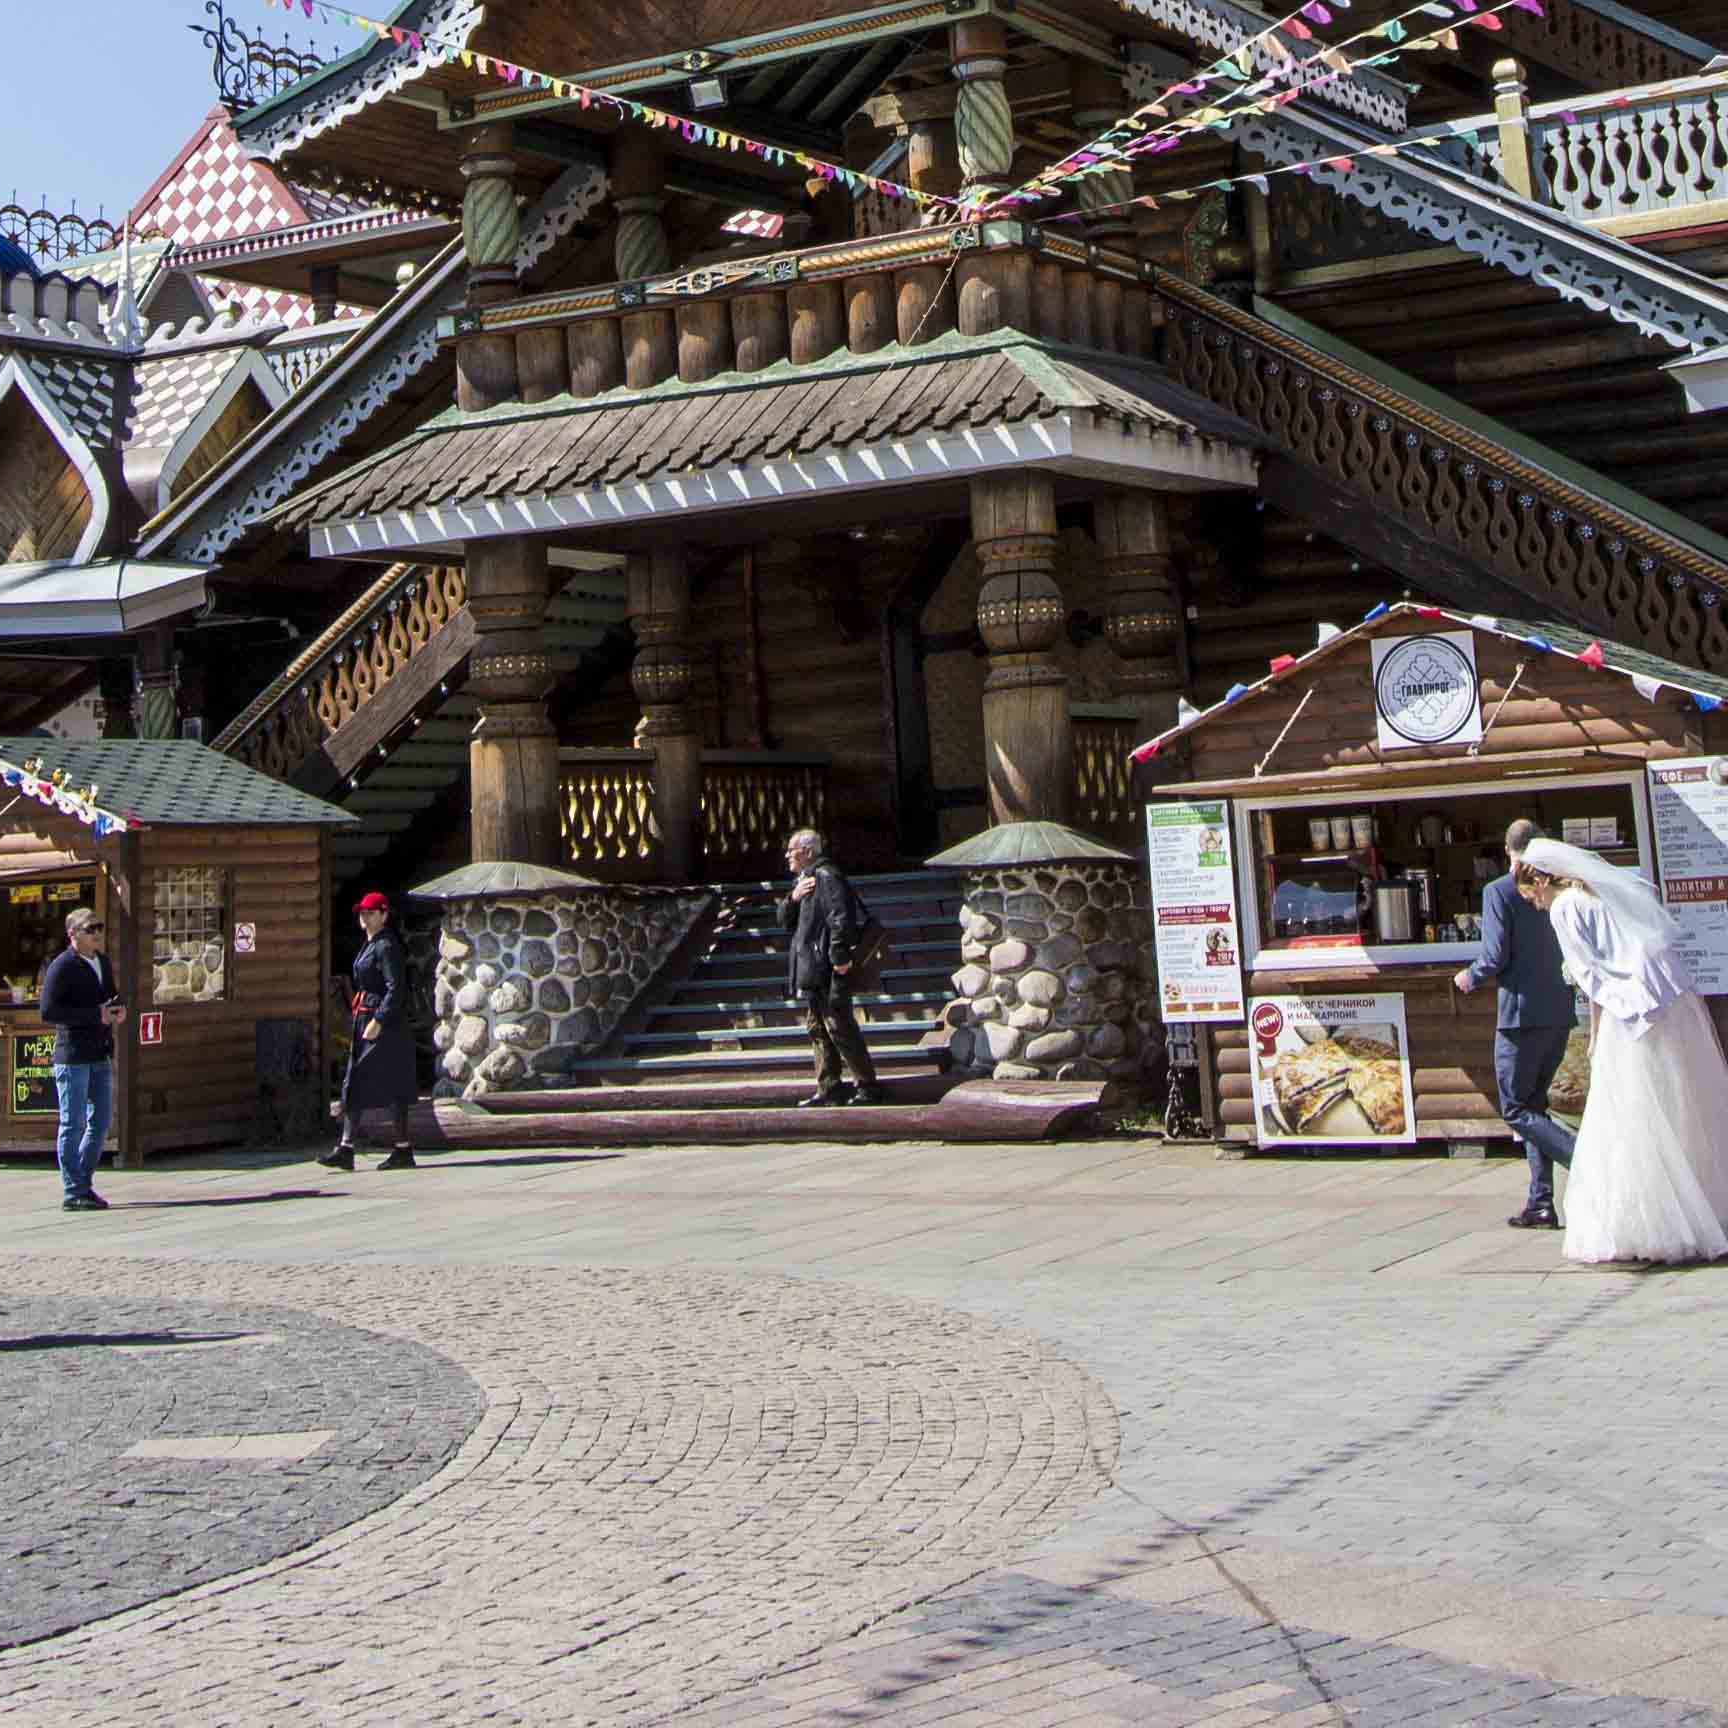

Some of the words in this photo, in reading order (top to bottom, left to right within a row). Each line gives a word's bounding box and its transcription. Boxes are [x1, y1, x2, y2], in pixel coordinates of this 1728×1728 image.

[1402, 681, 1450, 697] ГЛАВПИРОГ
[1668, 879, 1713, 893] НАПИТКИ
[1718, 879, 1726, 890] И
[1286, 1001, 1315, 1010] ПИРОГ
[1317, 1000, 1325, 1010] С
[1325, 998, 1376, 1009] ЧЕРНИКОЙ
[1287, 1013, 1294, 1021] И
[1295, 1010, 1359, 1021] МАСКАРПОНЕ
